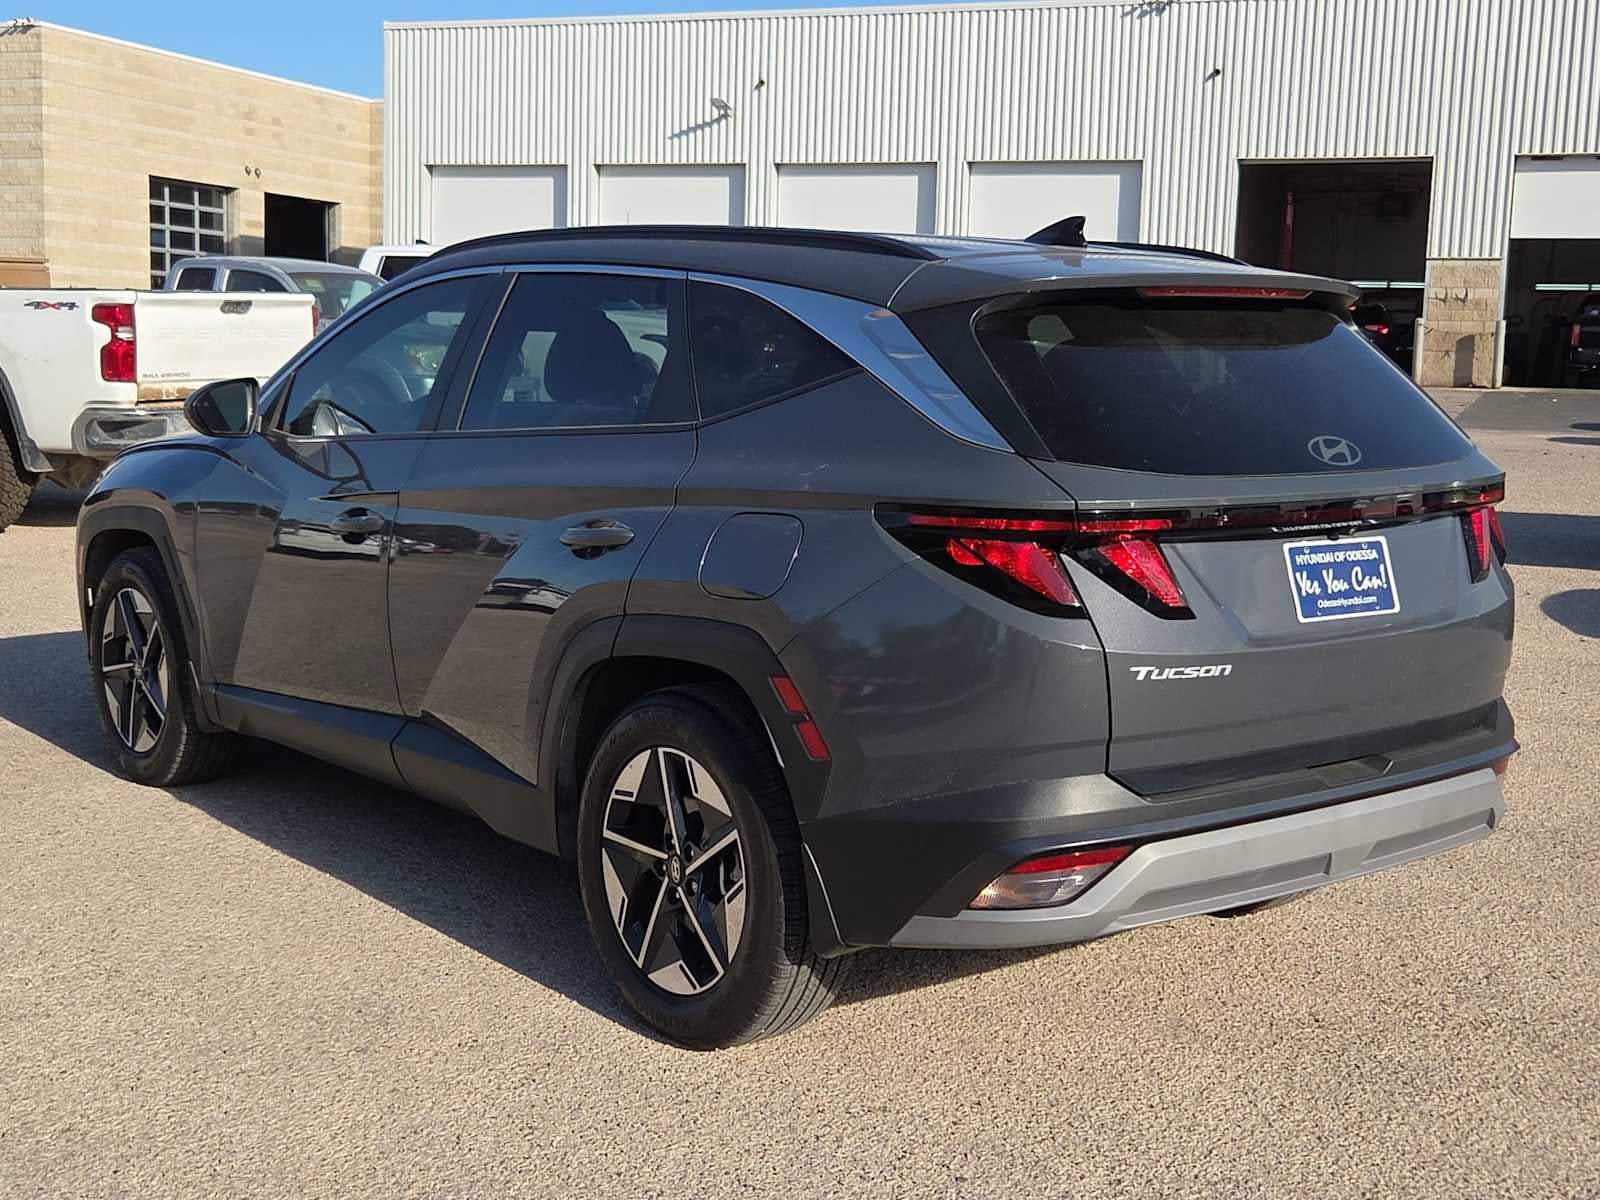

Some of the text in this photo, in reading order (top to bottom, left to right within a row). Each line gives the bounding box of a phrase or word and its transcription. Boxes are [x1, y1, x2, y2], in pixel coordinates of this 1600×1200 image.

[1295, 549, 1379, 565] HYUNDAI OF ODESSA
[1295, 563, 1388, 597] Yes You Can!
